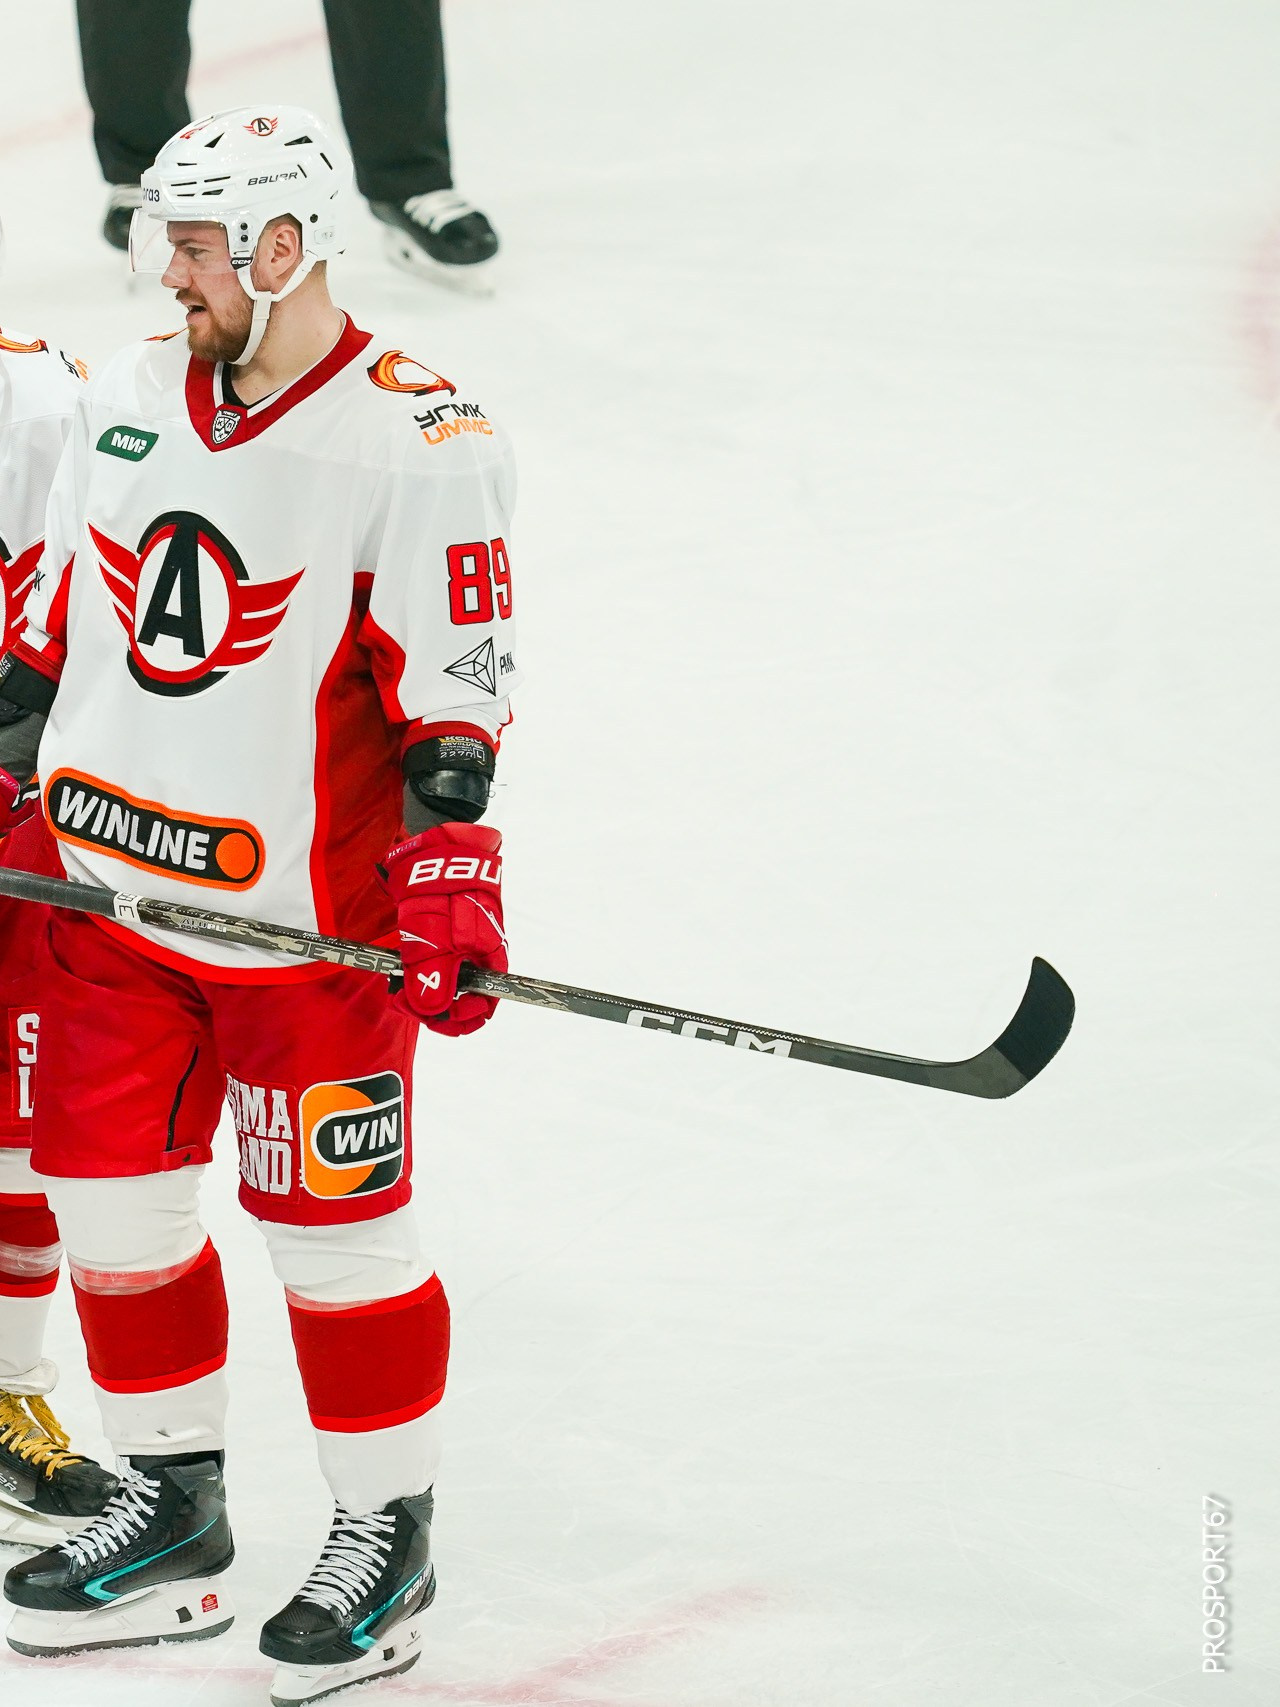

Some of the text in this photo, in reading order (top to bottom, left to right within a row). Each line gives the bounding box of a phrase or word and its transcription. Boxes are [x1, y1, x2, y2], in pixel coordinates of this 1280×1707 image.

[413, 403, 486, 430] УГМК
[422, 418, 493, 446] UMMC
[111, 431, 147, 453] МИР
[446, 537, 513, 625] 89
[57, 785, 210, 871] WINLINE
[407, 857, 502, 888] BAU
[285, 940, 402, 973] JETSP
[626, 1009, 792, 1059] CCM
[333, 1112, 398, 1156] WIN
